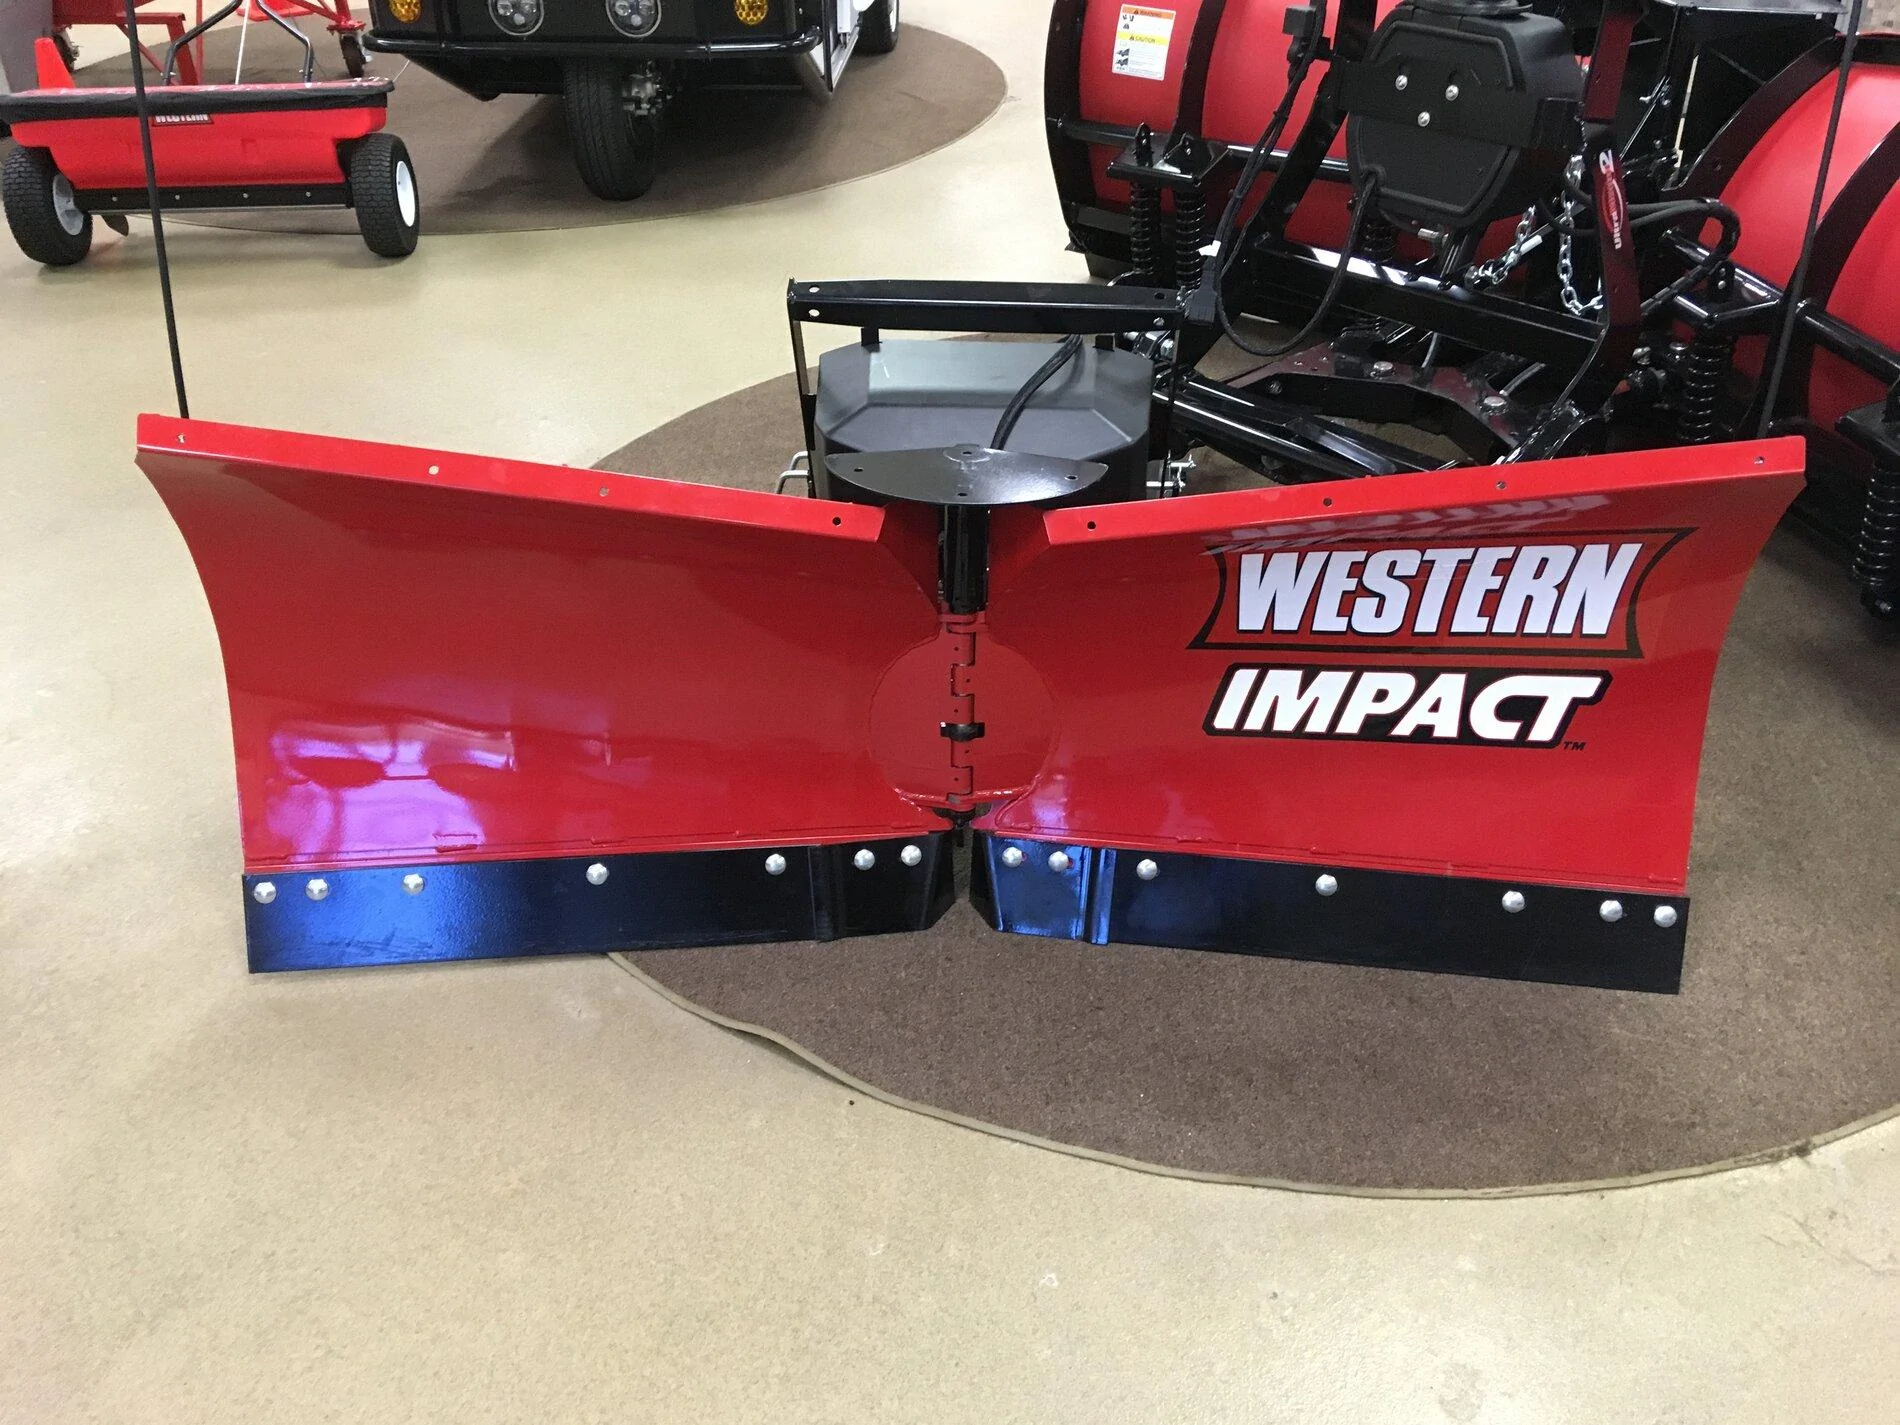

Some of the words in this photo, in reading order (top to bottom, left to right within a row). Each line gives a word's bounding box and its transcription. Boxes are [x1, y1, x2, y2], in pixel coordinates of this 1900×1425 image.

[1134, 36, 1156, 44] CAUTION
[1236, 542, 1643, 637] WESTERN
[1212, 668, 1603, 742] IMPACT
